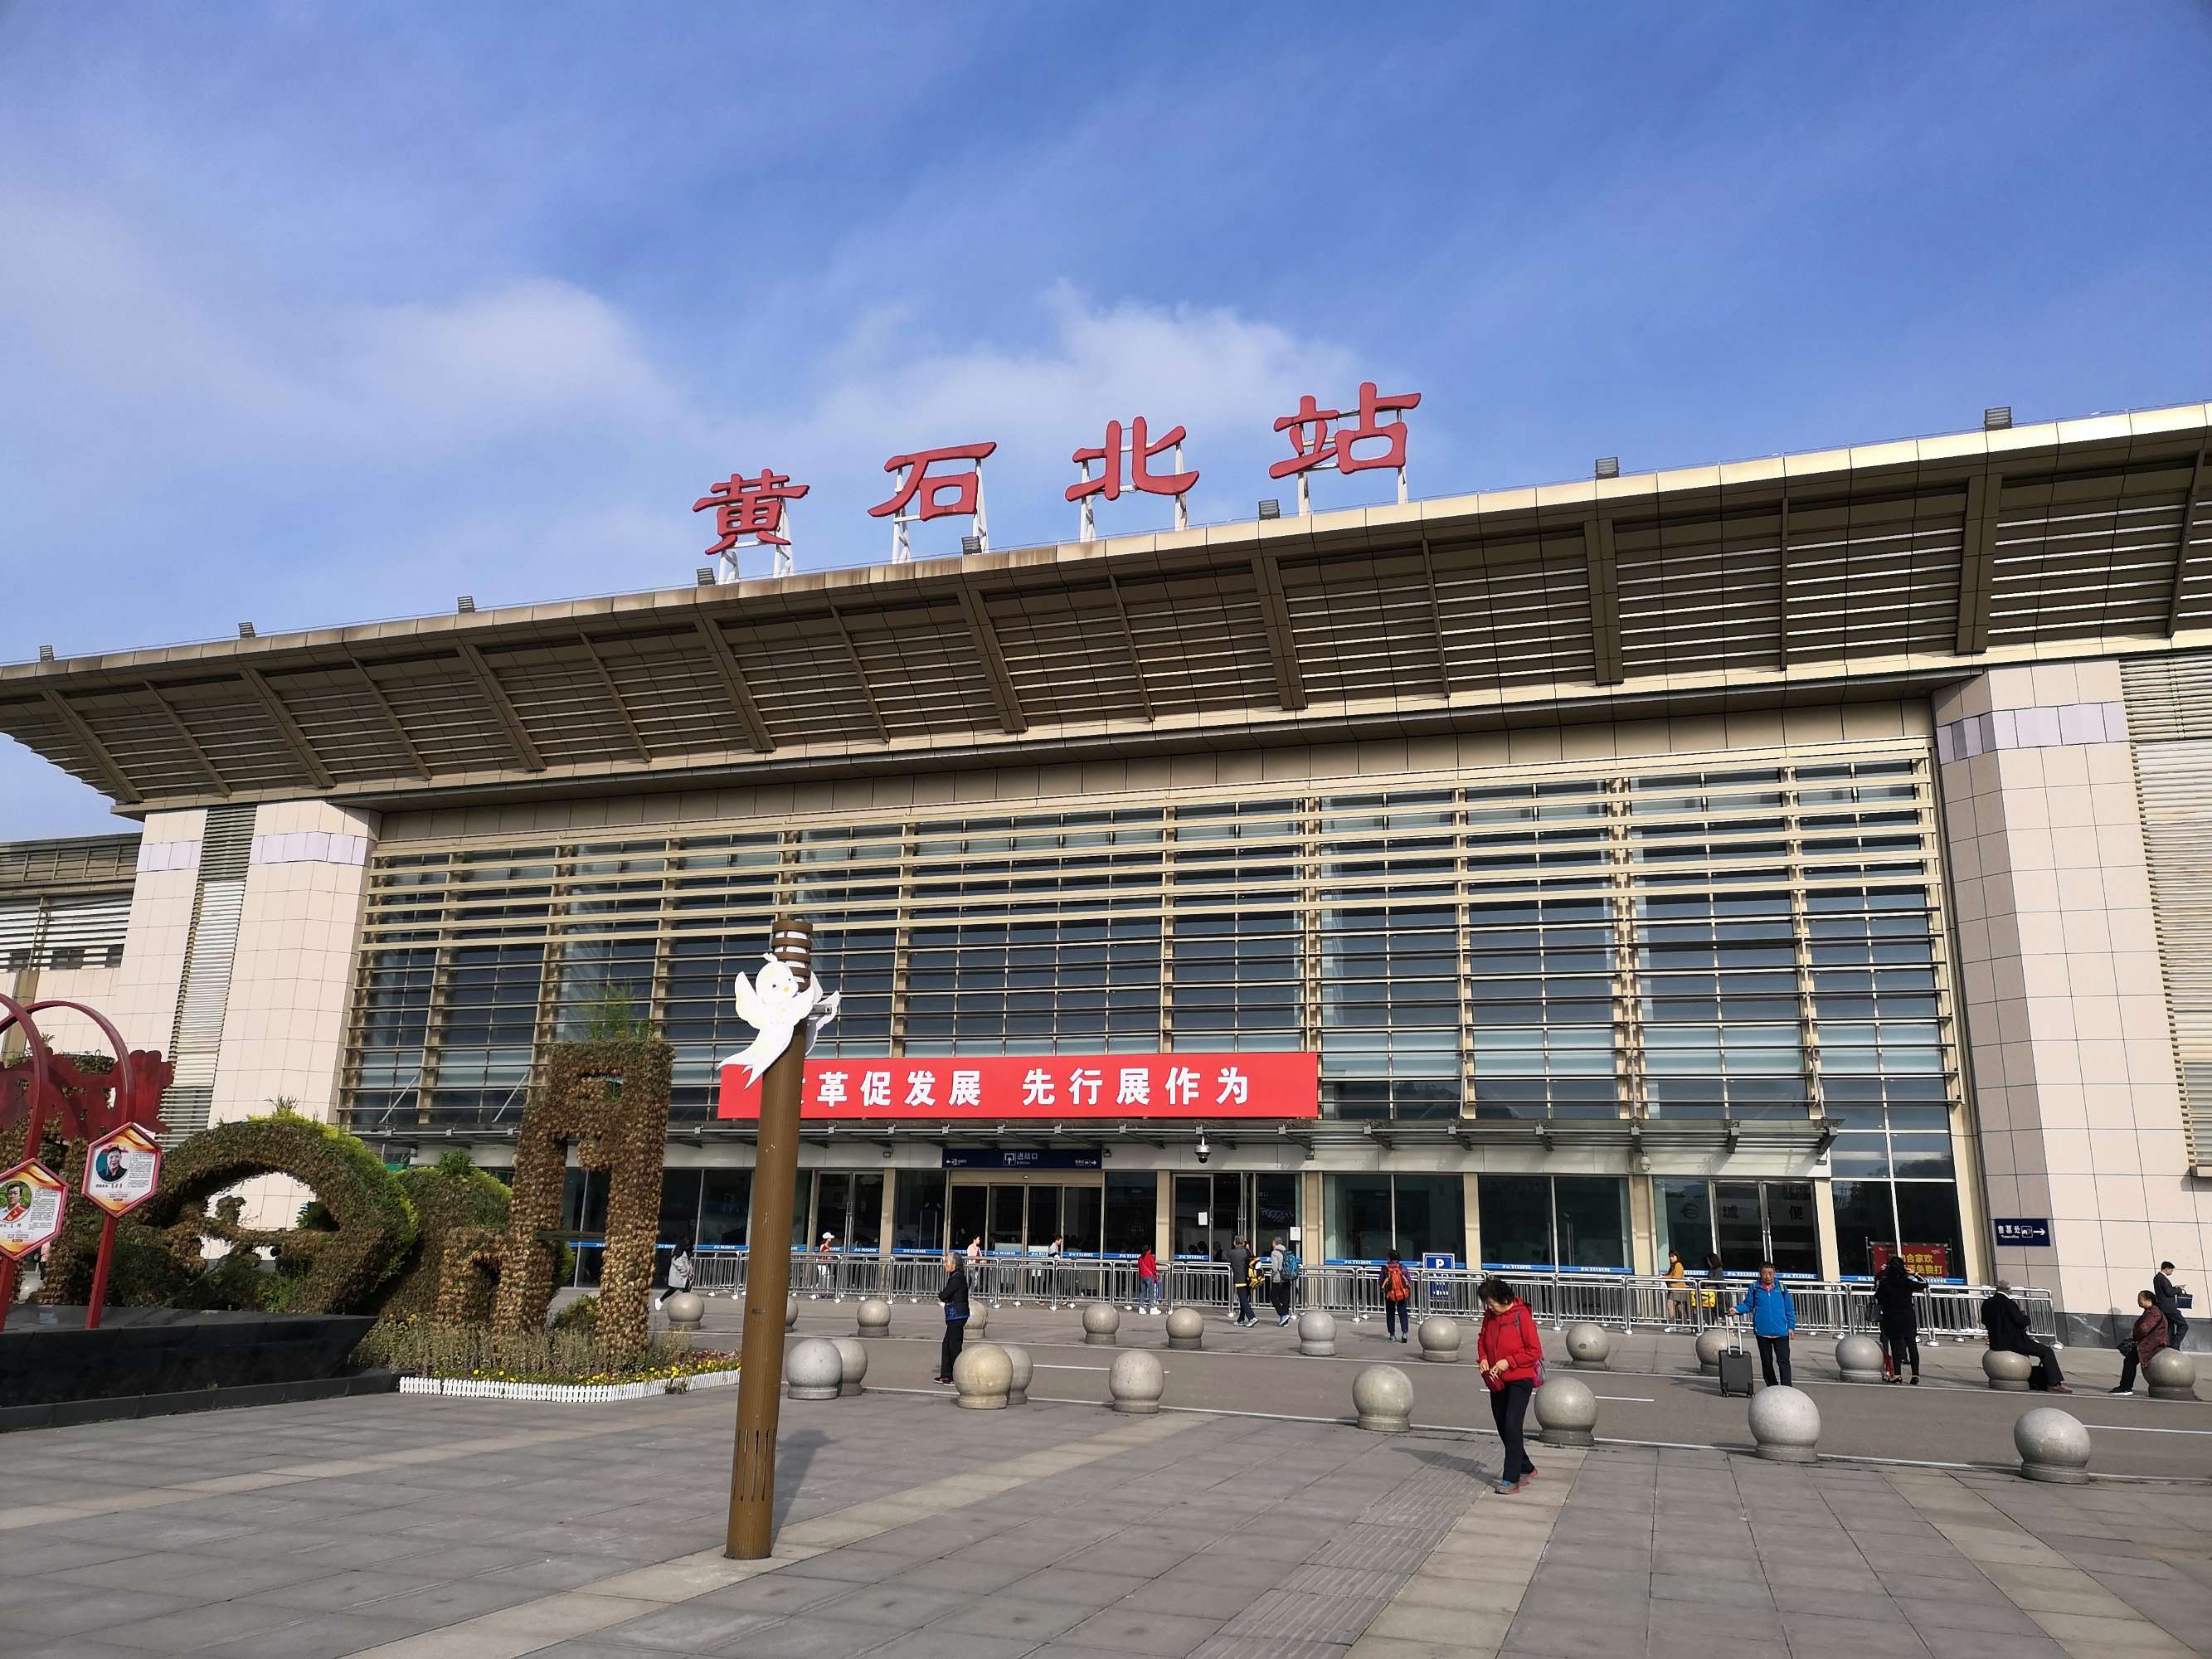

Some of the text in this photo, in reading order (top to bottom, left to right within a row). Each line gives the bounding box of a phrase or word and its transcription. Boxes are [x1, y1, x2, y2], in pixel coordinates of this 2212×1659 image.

[693, 382, 1422, 555] 黄石北站
[801, 1068, 1248, 1107] 革促发展 先行展作为
[1017, 1152, 1038, 1160] 进站口
[1997, 1224, 2021, 1234] 售票处
[1436, 1258, 1445, 1269] P
